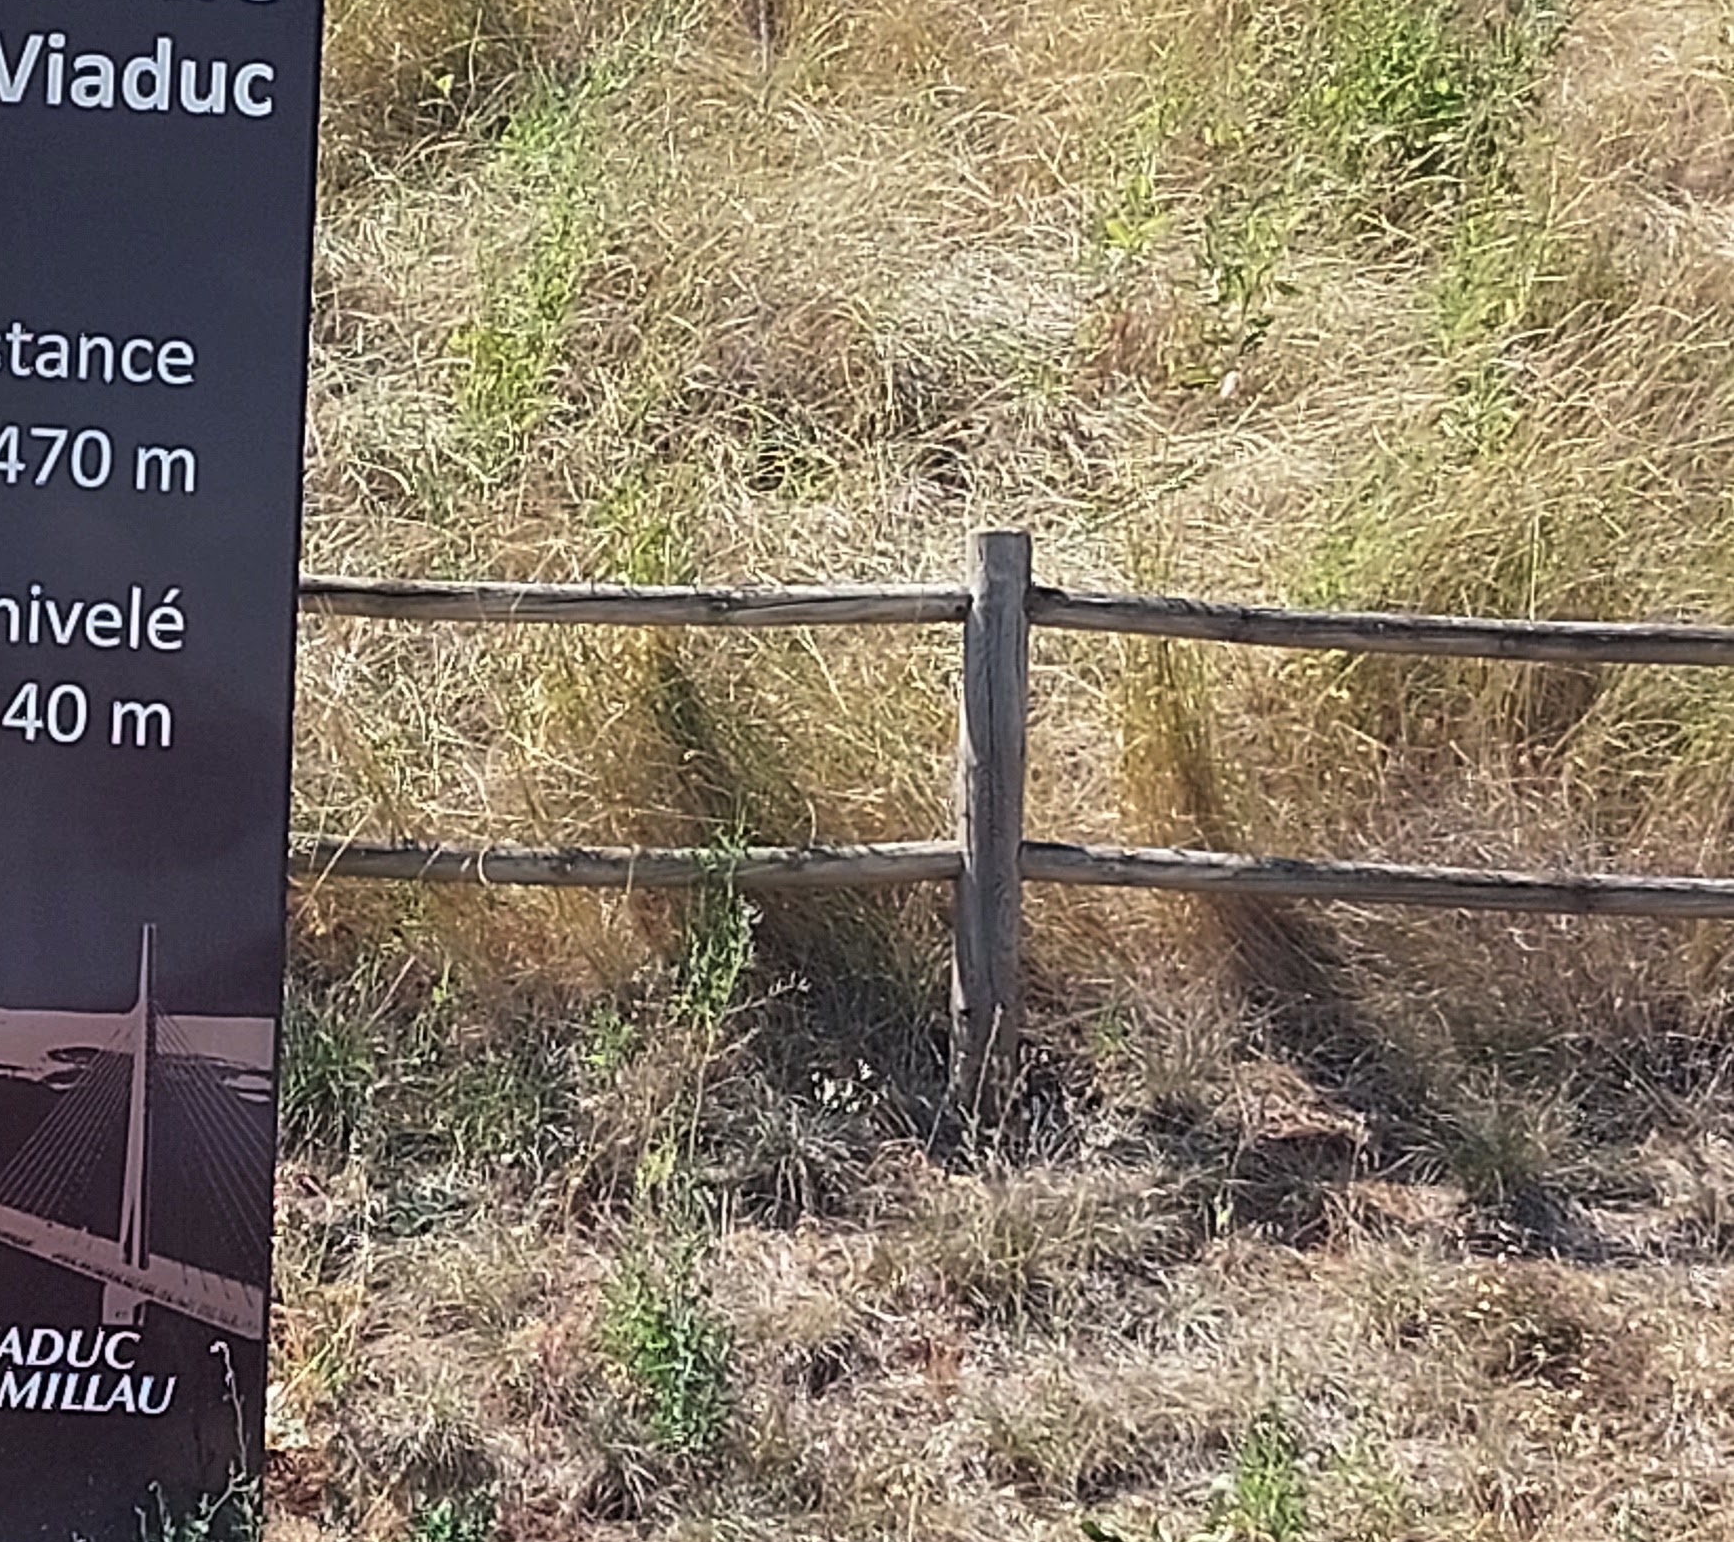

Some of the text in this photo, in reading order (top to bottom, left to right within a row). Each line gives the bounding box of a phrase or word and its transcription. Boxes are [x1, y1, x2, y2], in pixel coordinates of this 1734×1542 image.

[135, 447, 196, 493] m
[1, 682, 172, 748] 40 m
